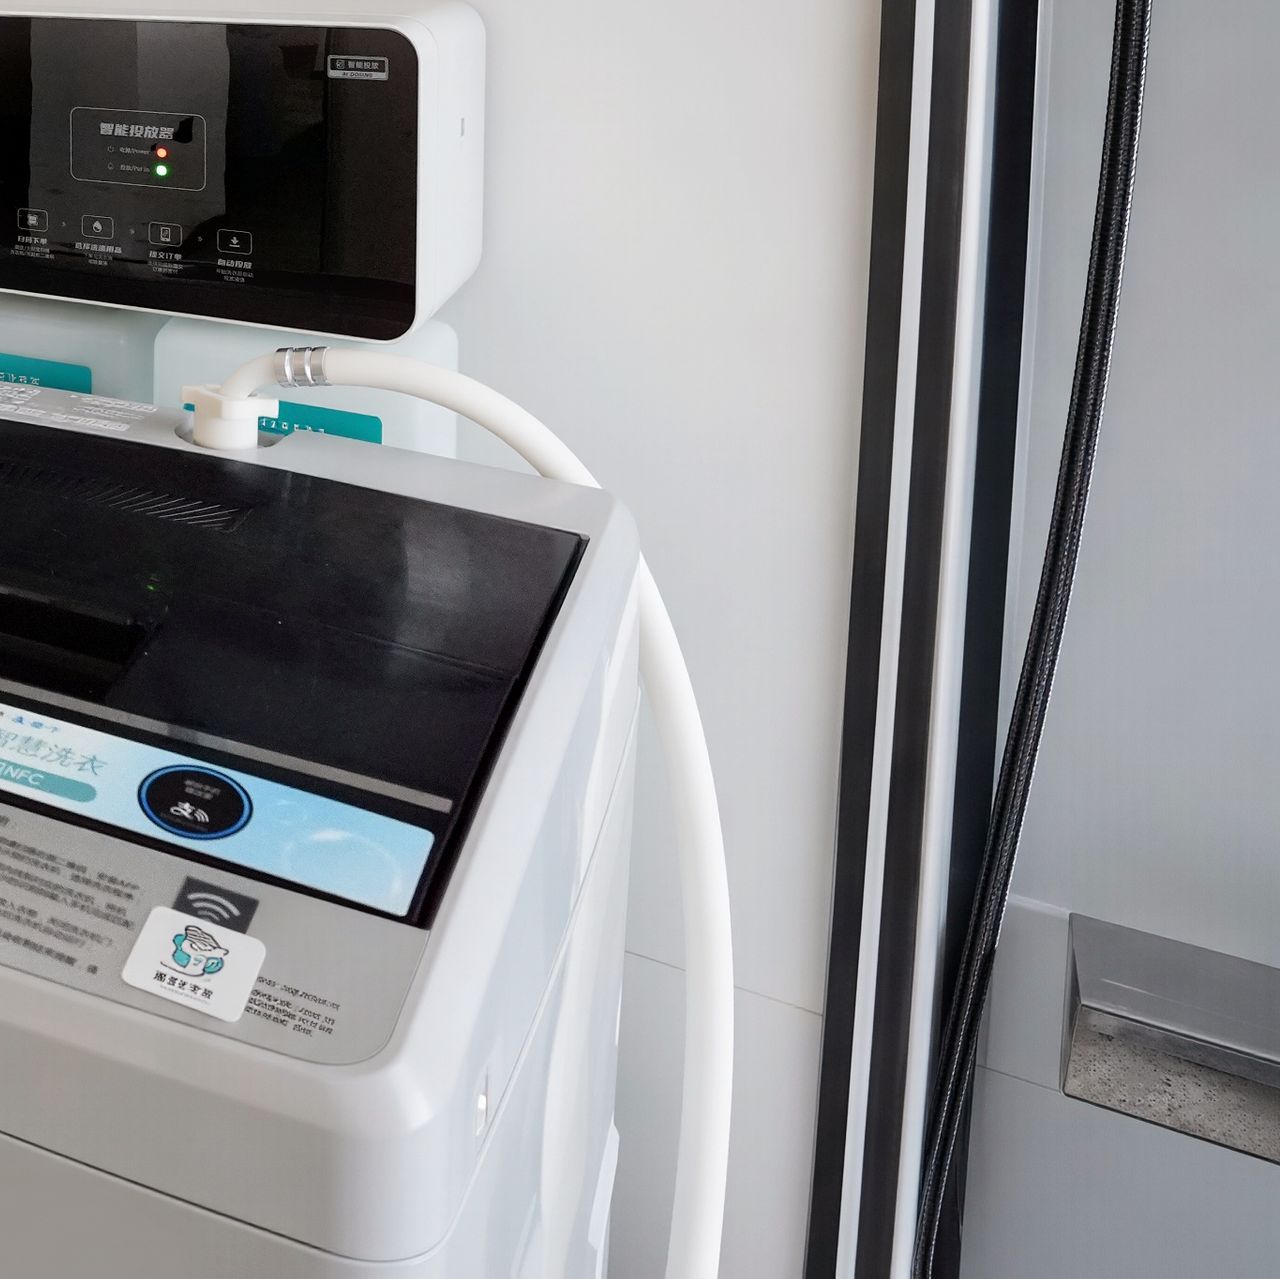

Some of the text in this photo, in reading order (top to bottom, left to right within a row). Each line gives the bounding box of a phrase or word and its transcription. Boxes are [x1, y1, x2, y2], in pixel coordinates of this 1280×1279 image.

[99, 122, 175, 140] 智能投放器
